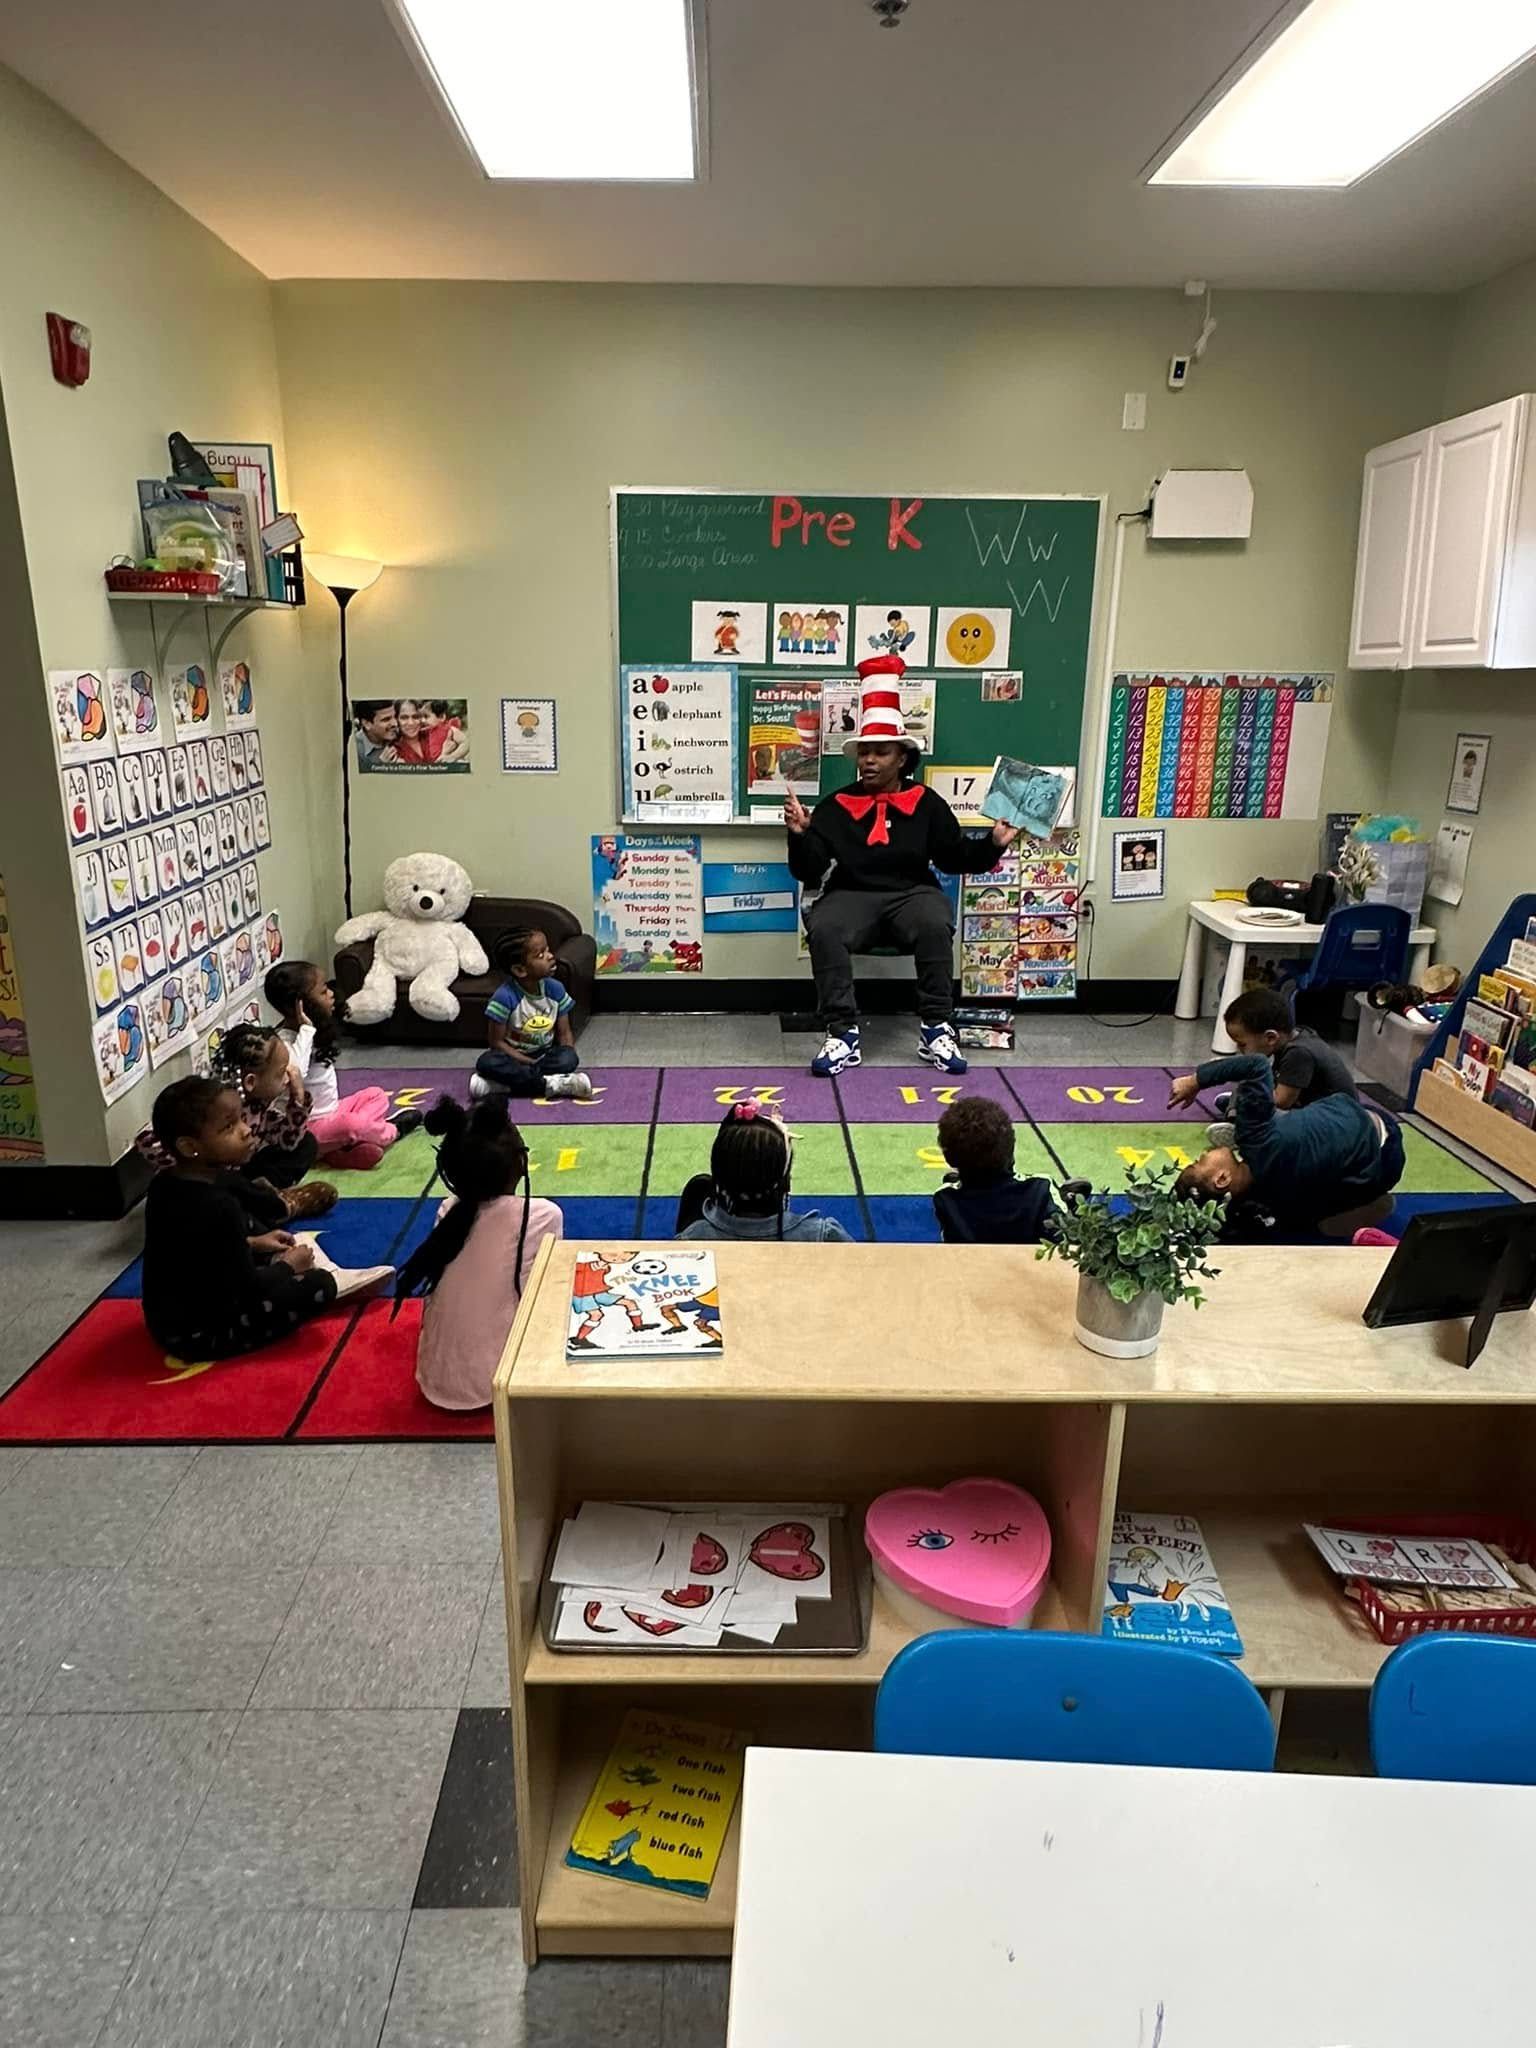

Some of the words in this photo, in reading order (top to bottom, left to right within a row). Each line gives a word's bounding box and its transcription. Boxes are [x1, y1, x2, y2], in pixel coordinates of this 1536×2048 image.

[772, 496, 855, 548] Pre
[888, 496, 923, 549] K
[633, 678, 649, 694] a
[672, 681, 704, 694] apple
[1132, 688, 1145, 699] 10
[1168, 688, 1183, 699] 30
[1186, 688, 1202, 700] 40
[1223, 689, 1239, 700] 60
[1241, 689, 1257, 700] 70
[756, 690, 779, 700] Let's
[781, 690, 802, 700] Find
[633, 704, 649, 720] e
[672, 708, 723, 721] elephant
[1131, 702, 1143, 713] 11
[1167, 702, 1181, 713] 31
[1184, 702, 1198, 713] 41
[1222, 702, 1234, 713] 61
[1241, 702, 1253, 713] 71
[1129, 715, 1144, 726] 12
[1165, 715, 1181, 726] 32
[1183, 715, 1199, 727] 42
[1220, 715, 1236, 727] 62
[1239, 715, 1254, 727] 72
[637, 729, 647, 751] i
[673, 736, 730, 747] inchworm
[68, 773, 86, 798] Aa
[95, 766, 114, 791] Bb
[122, 758, 139, 783] Cc
[145, 753, 162, 777] Dd
[172, 750, 185, 774] Ee
[191, 743, 203, 765] Ff
[210, 739, 225, 764] Gg
[229, 736, 242, 757] Hh
[634, 761, 650, 777] o
[674, 765, 714, 775] ostrich
[953, 778, 976, 796] 17
[675, 791, 726, 801] umbrella
[87, 855, 98, 888] Jj
[107, 848, 127, 873] Kk
[136, 838, 149, 864] Ll
[156, 831, 176, 853] Mm
[180, 827, 195, 848] Nn
[200, 816, 214, 837] Oo
[219, 809, 232, 832] Pp
[626, 836, 654, 848] Days
[663, 835, 694, 846] Week
[632, 854, 669, 863] Sunday
[631, 866, 669, 875] Monday
[733, 865, 756, 874] Today
[628, 879, 670, 888] Tuesday
[1032, 874, 1068, 887] August
[613, 891, 670, 901] Wednesday
[733, 896, 765, 909] Friday
[625, 904, 670, 913] Thursday
[976, 901, 1009, 911] March
[639, 916, 670, 926] Friday
[95, 943, 110, 969] Ss
[118, 929, 134, 953] Tt
[165, 907, 182, 928] Vv
[185, 897, 204, 917] Ww
[625, 929, 671, 938] Saturday
[980, 955, 1003, 968] May
[713, 1086, 786, 1105] 22
[897, 1086, 963, 1105] 21
[1066, 1085, 1145, 1105] 20
[629, 1274, 701, 1297] KNEE
[653, 1287, 695, 1304] BOOK
[1141, 1534, 1202, 1553] FEET
[1338, 1538, 1358, 1554] Q
[1415, 1548, 1436, 1564] R
[677, 1756, 700, 1769] One
[702, 1760, 727, 1775] fish
[671, 1783, 696, 1796] two
[697, 1787, 721, 1803] fish
[657, 1810, 679, 1822] red
[681, 1813, 706, 1829] fish
[649, 1835, 676, 1853] blue
[678, 1842, 704, 1860] fish
